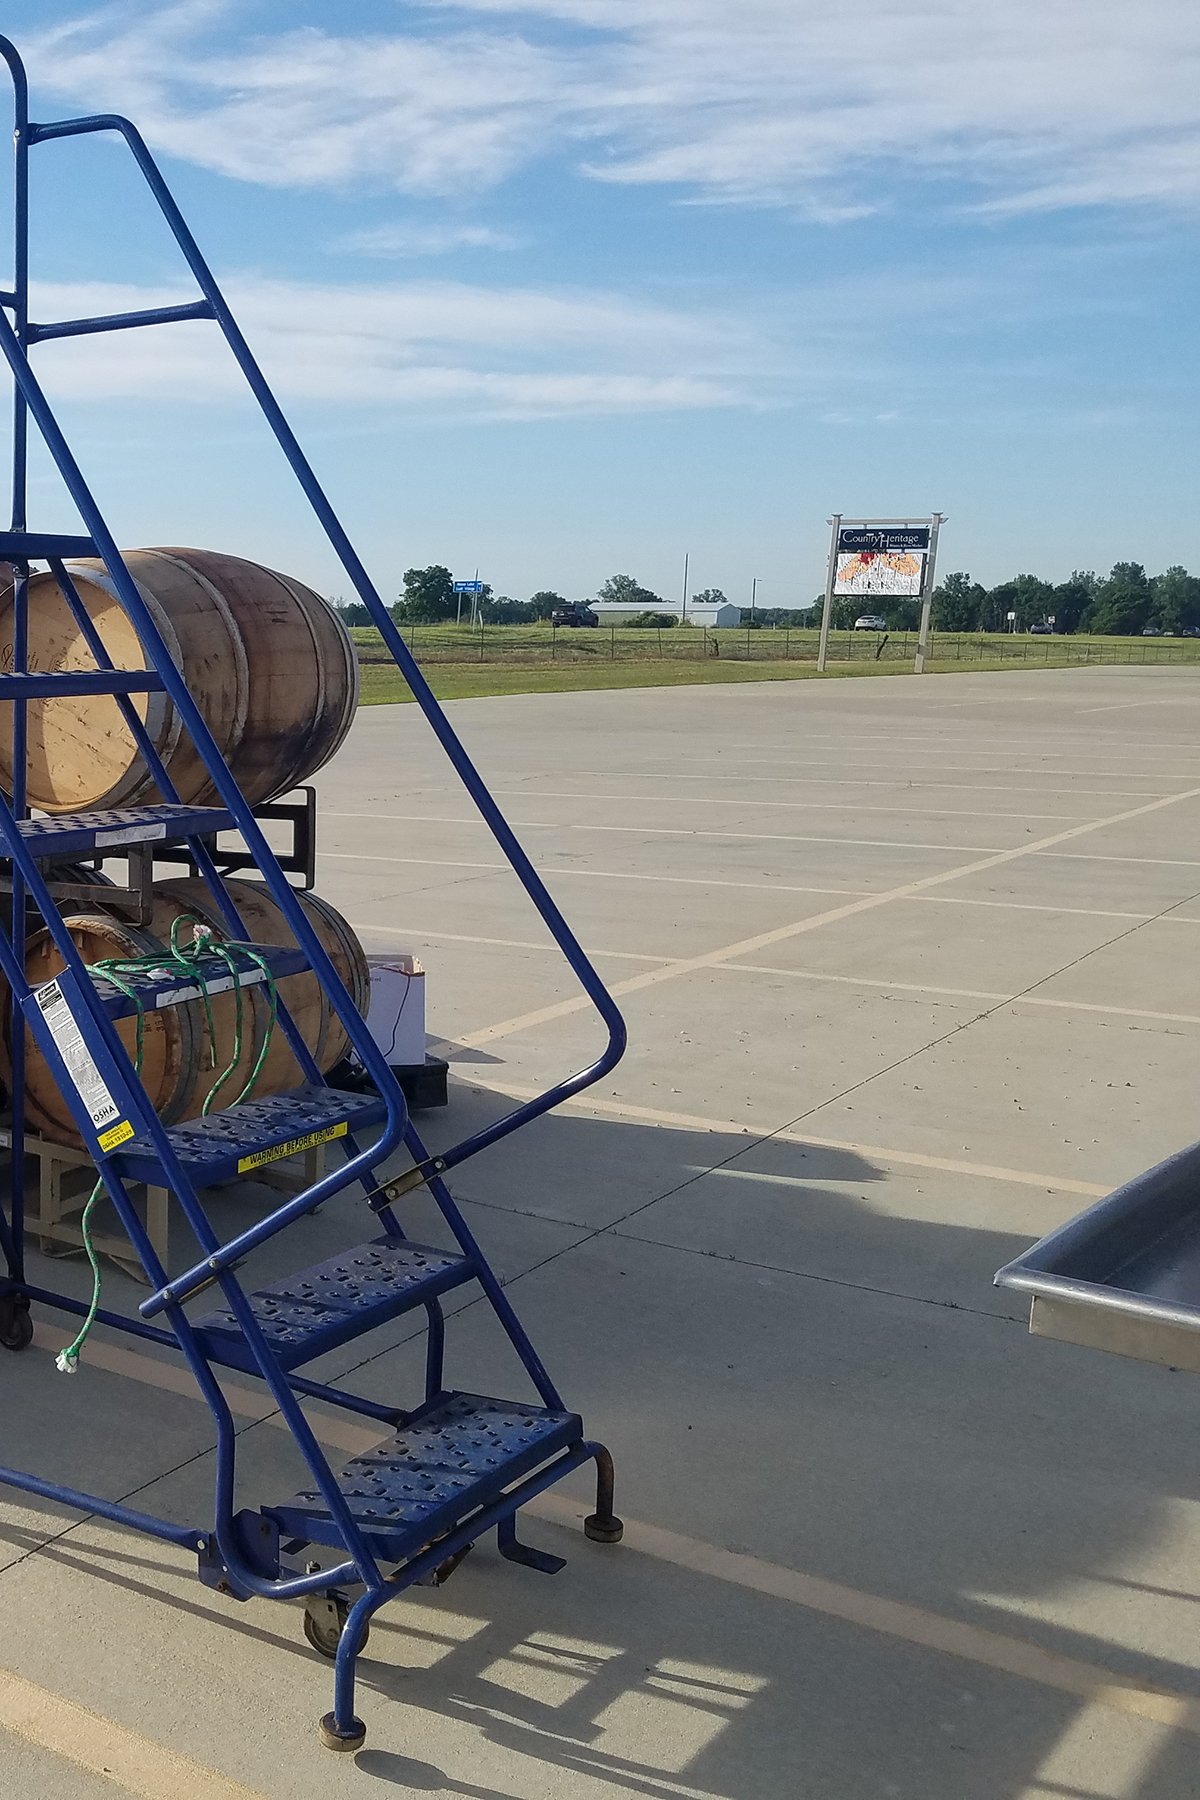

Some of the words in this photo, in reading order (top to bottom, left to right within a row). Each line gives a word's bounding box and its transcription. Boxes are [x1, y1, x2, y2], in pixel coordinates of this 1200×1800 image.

[879, 532, 919, 548] Heritage
[93, 1104, 116, 1122] OSHA
[249, 1145, 285, 1165] WARNING
[286, 1134, 312, 1151] BEFORE
